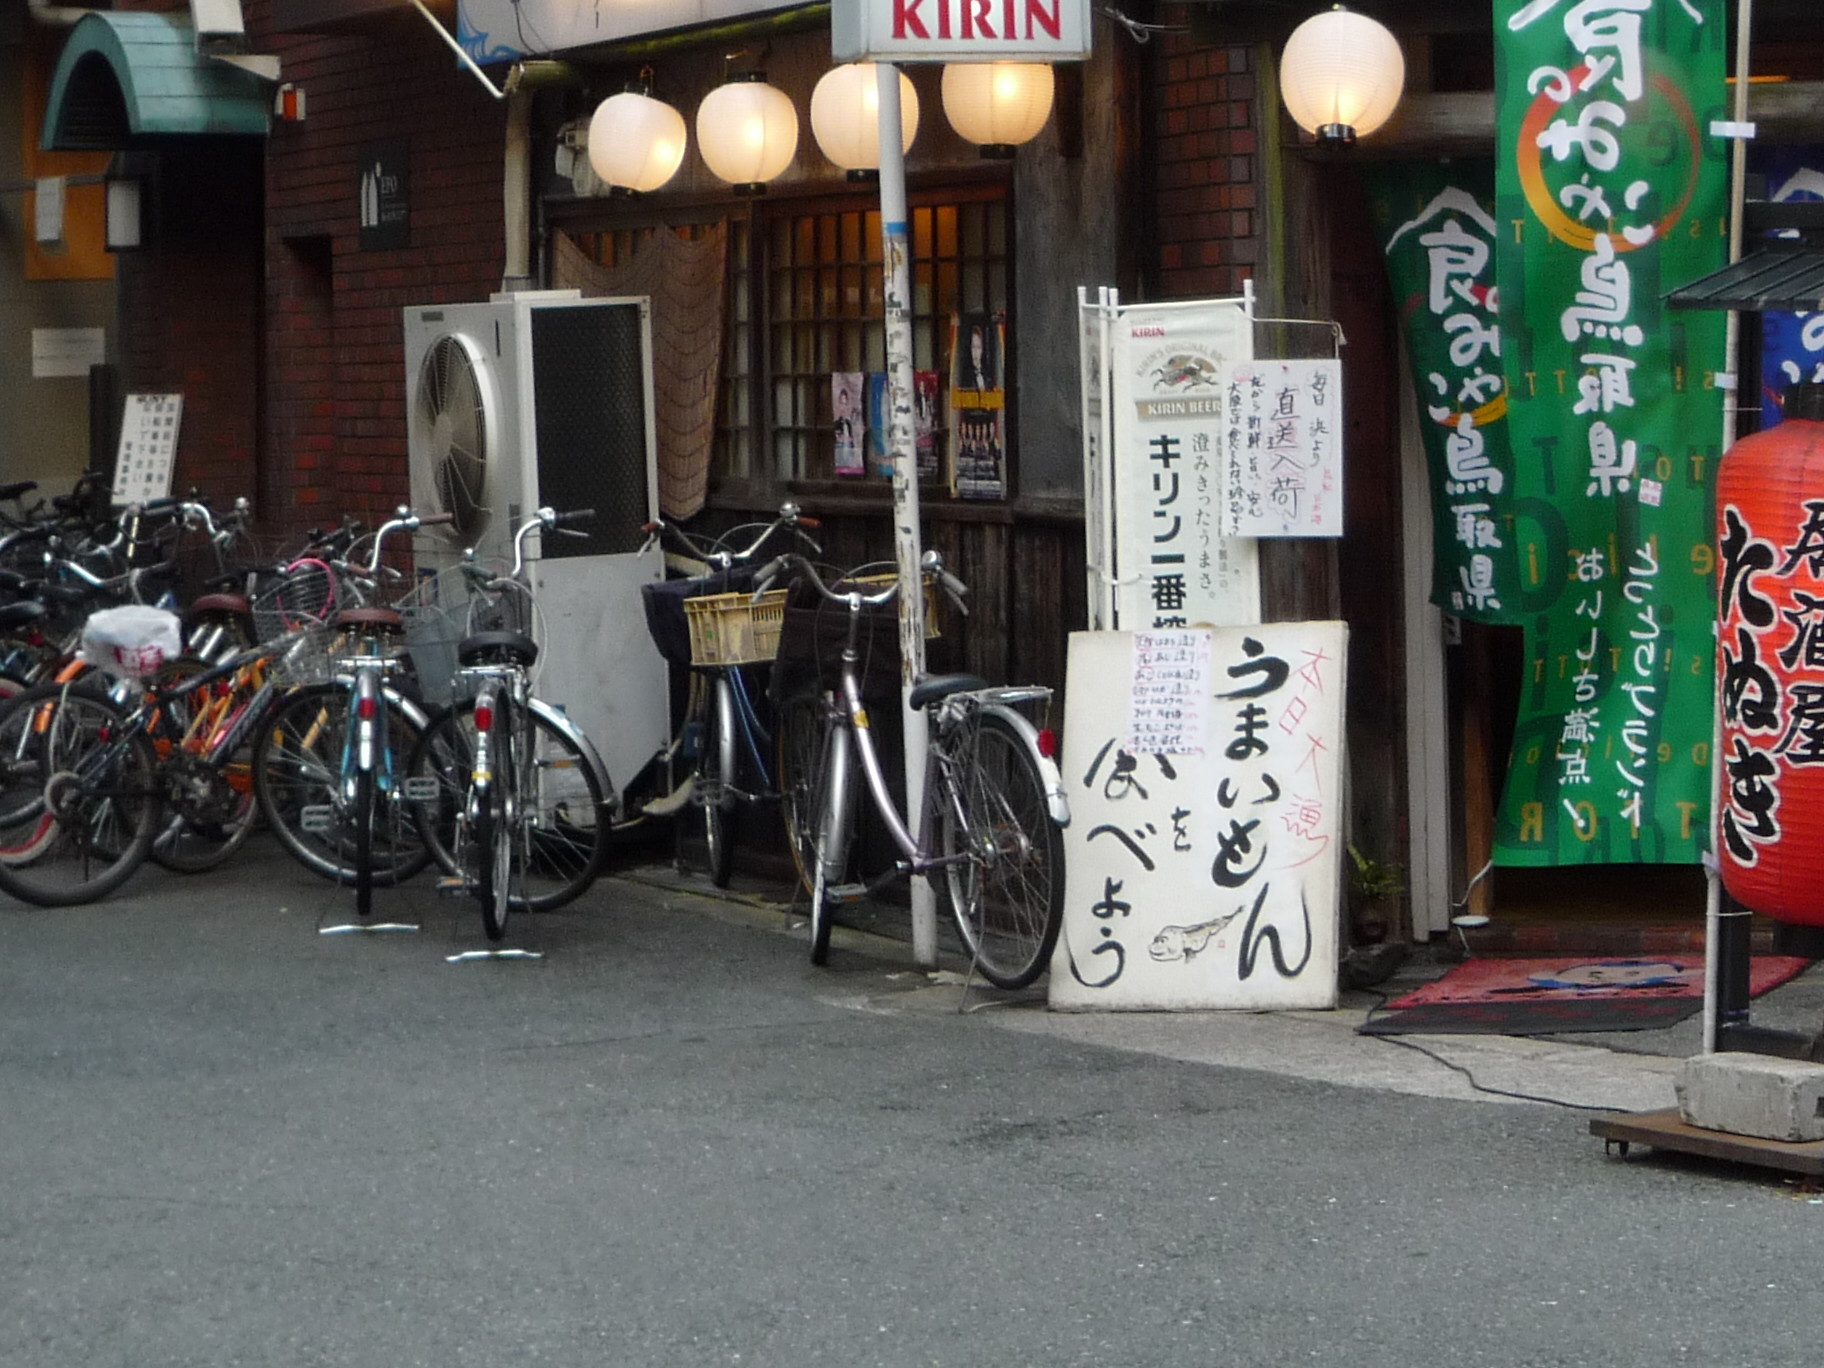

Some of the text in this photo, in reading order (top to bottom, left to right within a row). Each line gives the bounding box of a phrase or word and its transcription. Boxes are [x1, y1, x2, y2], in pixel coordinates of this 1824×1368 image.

[1132, 327, 1165, 338] KIRIN
[1148, 400, 1221, 415] KIRIN BEER
[1268, 387, 1305, 519] 直送入荷
[1719, 504, 1783, 868] たぬき
